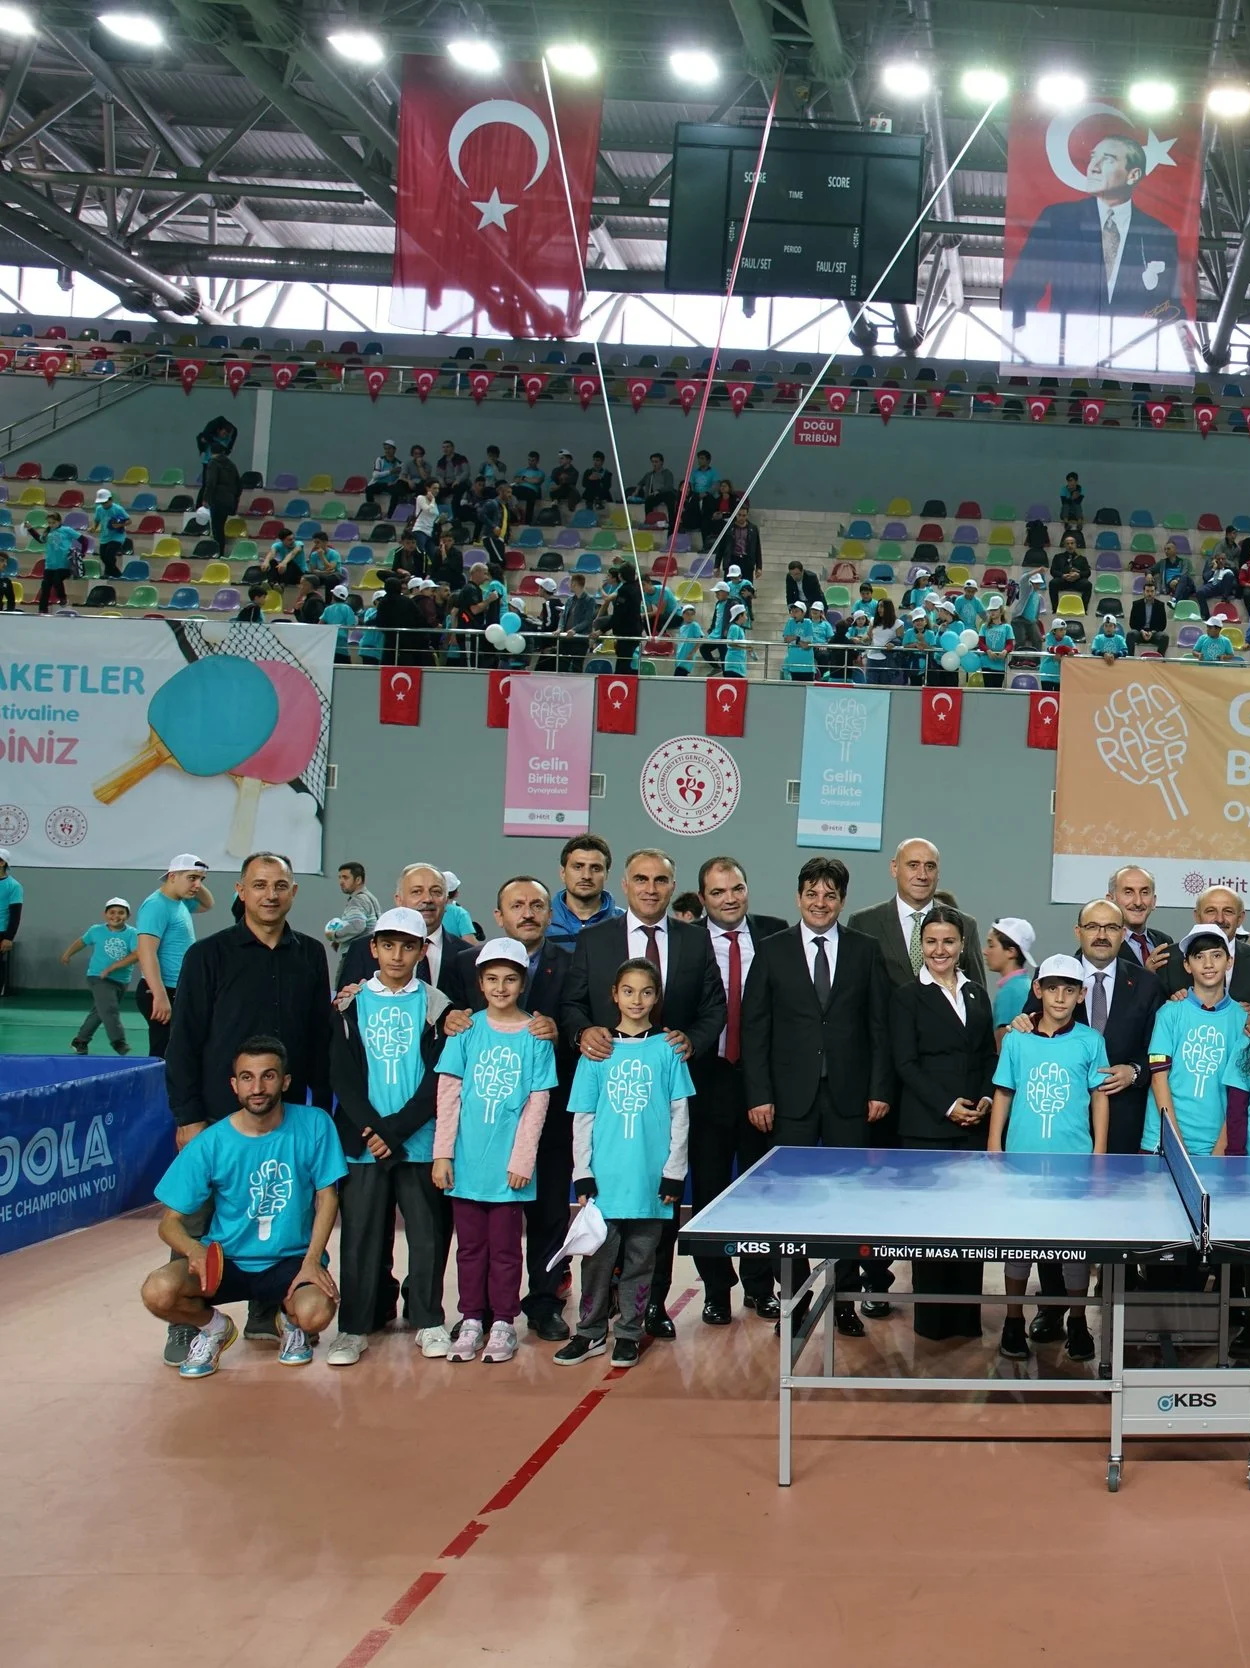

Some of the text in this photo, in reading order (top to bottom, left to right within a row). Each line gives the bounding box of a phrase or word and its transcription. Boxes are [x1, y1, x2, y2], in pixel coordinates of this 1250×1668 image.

[828, 176, 850, 188] SCORE
[789, 190, 804, 200] TIME
[784, 245, 802, 254] PERIOD
[741, 257, 772, 270] FAUL/SET
[816, 260, 847, 273] FAUL/SET
[803, 420, 834, 430] DOĞU
[799, 432, 837, 443] TRİBÜN
[1094, 682, 1176, 733] UÇAN
[1096, 704, 1188, 772] RAKET
[528, 757, 568, 771] Gelin
[1119, 740, 1187, 785] LER
[528, 774, 568, 785] Birlikte
[823, 768, 862, 783] Gelin
[822, 785, 862, 797] Birlikte
[368, 1006, 413, 1027] UÇAN
[365, 1026, 414, 1052] RAKET
[1187, 1024, 1225, 1047] UÇAN
[479, 1045, 521, 1069] UÇAN
[1182, 1041, 1226, 1066] RAKET
[609, 1058, 652, 1081] UÇAN
[1030, 1061, 1070, 1084] UÇAN
[1185, 1060, 1219, 1075] LER
[473, 1063, 522, 1088] RAKET
[476, 1084, 514, 1099] LER
[607, 1079, 653, 1102] RAKET
[1026, 1080, 1070, 1104] RAKET
[611, 1098, 649, 1114] LER
[1029, 1100, 1065, 1114] LER
[15, 1185, 77, 1219] CHAMPION
[79, 1180, 92, 1197] IN
[93, 1174, 116, 1194] YOU
[736, 1242, 807, 1255] KBS 18-1
[872, 1245, 1087, 1260] TÜRKİYE MASA TENİSİ FEDERASYONU
[1174, 1392, 1217, 1408] KBS
